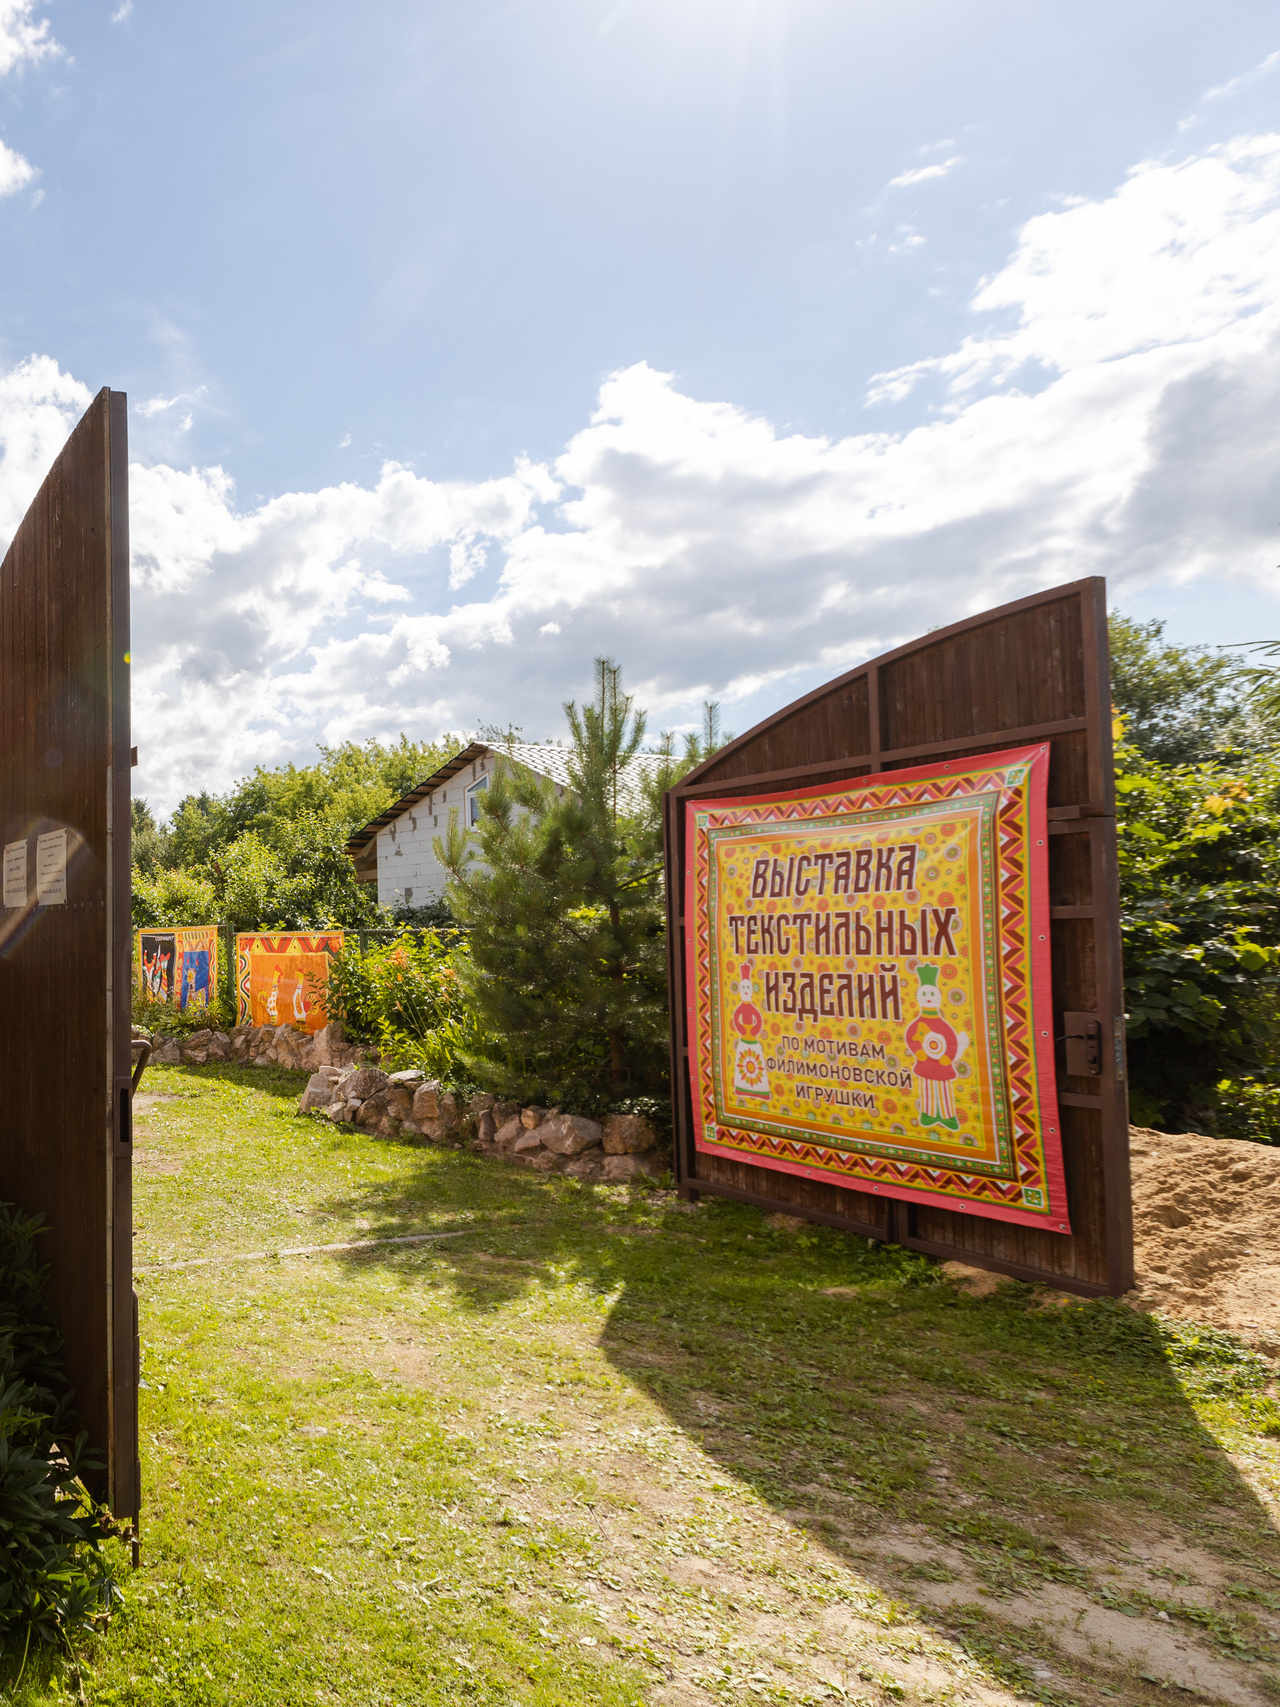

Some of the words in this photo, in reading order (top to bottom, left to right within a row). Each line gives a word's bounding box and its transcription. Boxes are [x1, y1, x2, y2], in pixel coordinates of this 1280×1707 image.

[751, 844, 918, 899] ВЫСТАВКА
[728, 907, 959, 957] ТЕКСТИЛЬНЫХ
[764, 963, 903, 1023] ИЗДЕЛИЙ
[782, 1036, 800, 1051] ПО
[804, 1037, 885, 1060] МОТИВАМ
[766, 1056, 913, 1089] ФИЛИМОНОВСКОЙ
[795, 1084, 876, 1110] ИГРУШКИ
